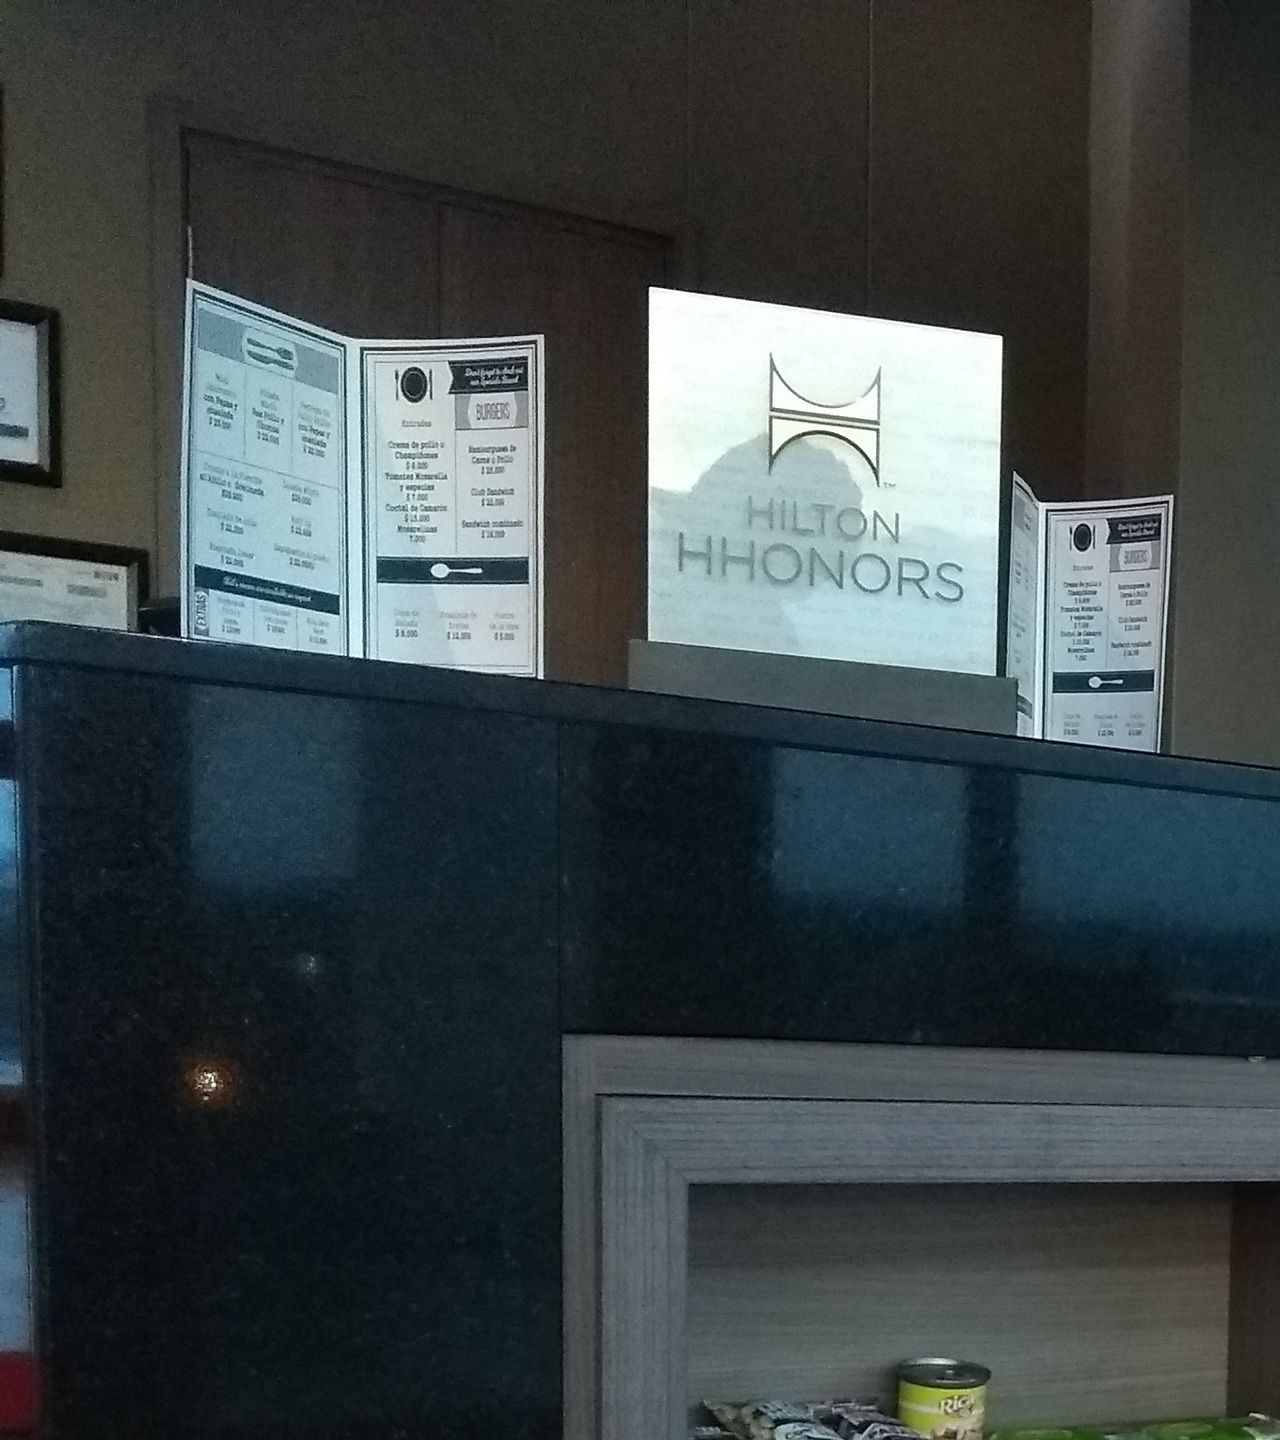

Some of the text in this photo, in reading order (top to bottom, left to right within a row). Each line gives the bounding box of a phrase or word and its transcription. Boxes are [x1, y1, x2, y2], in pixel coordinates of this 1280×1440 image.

[476, 402, 510, 421] BURGERS
[747, 494, 900, 544] HILTON
[678, 531, 965, 603] HHONORS
